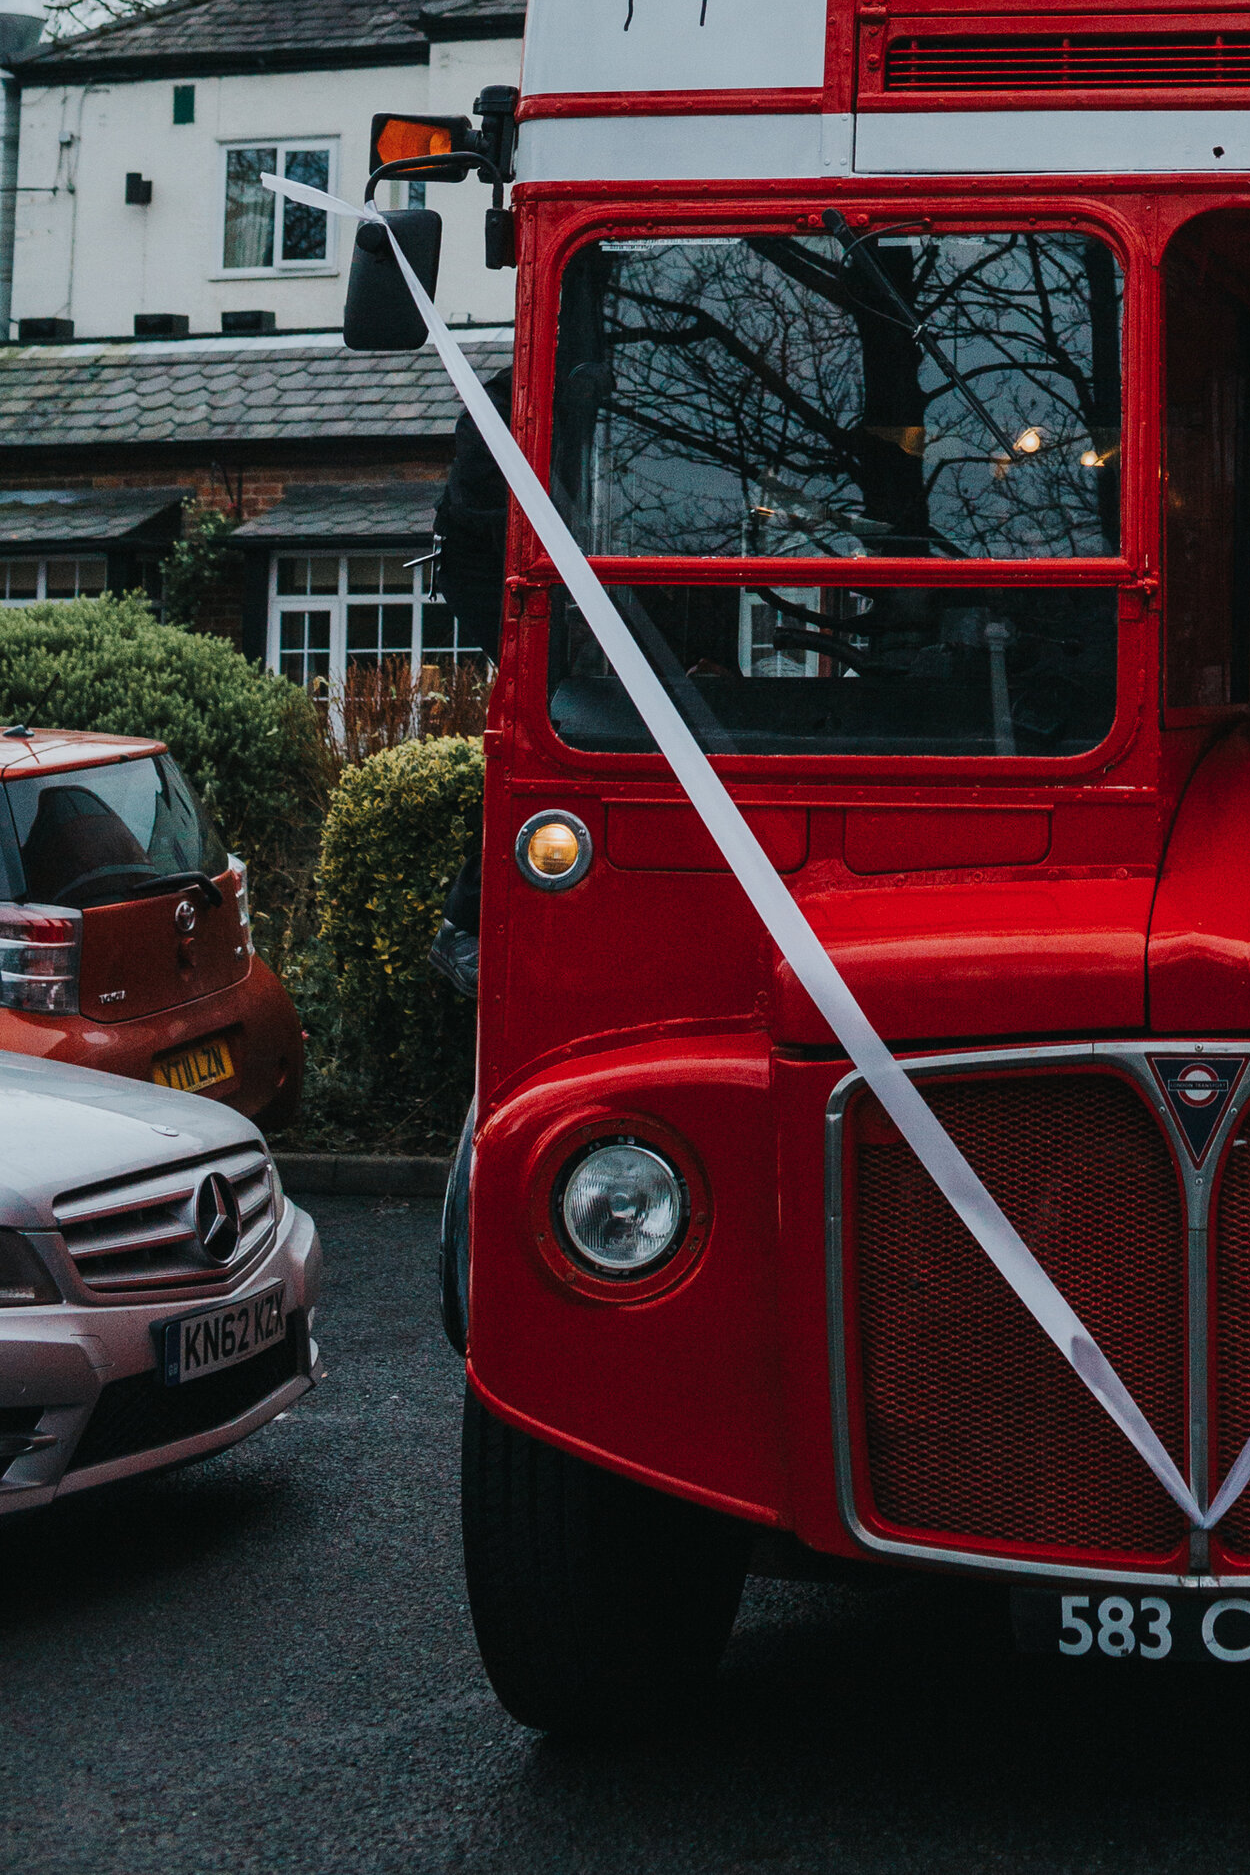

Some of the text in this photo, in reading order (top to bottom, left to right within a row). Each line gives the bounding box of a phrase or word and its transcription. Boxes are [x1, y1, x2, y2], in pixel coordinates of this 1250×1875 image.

[184, 1289, 284, 1371] KN62 KZX
[1058, 1595, 1173, 1660] 583
